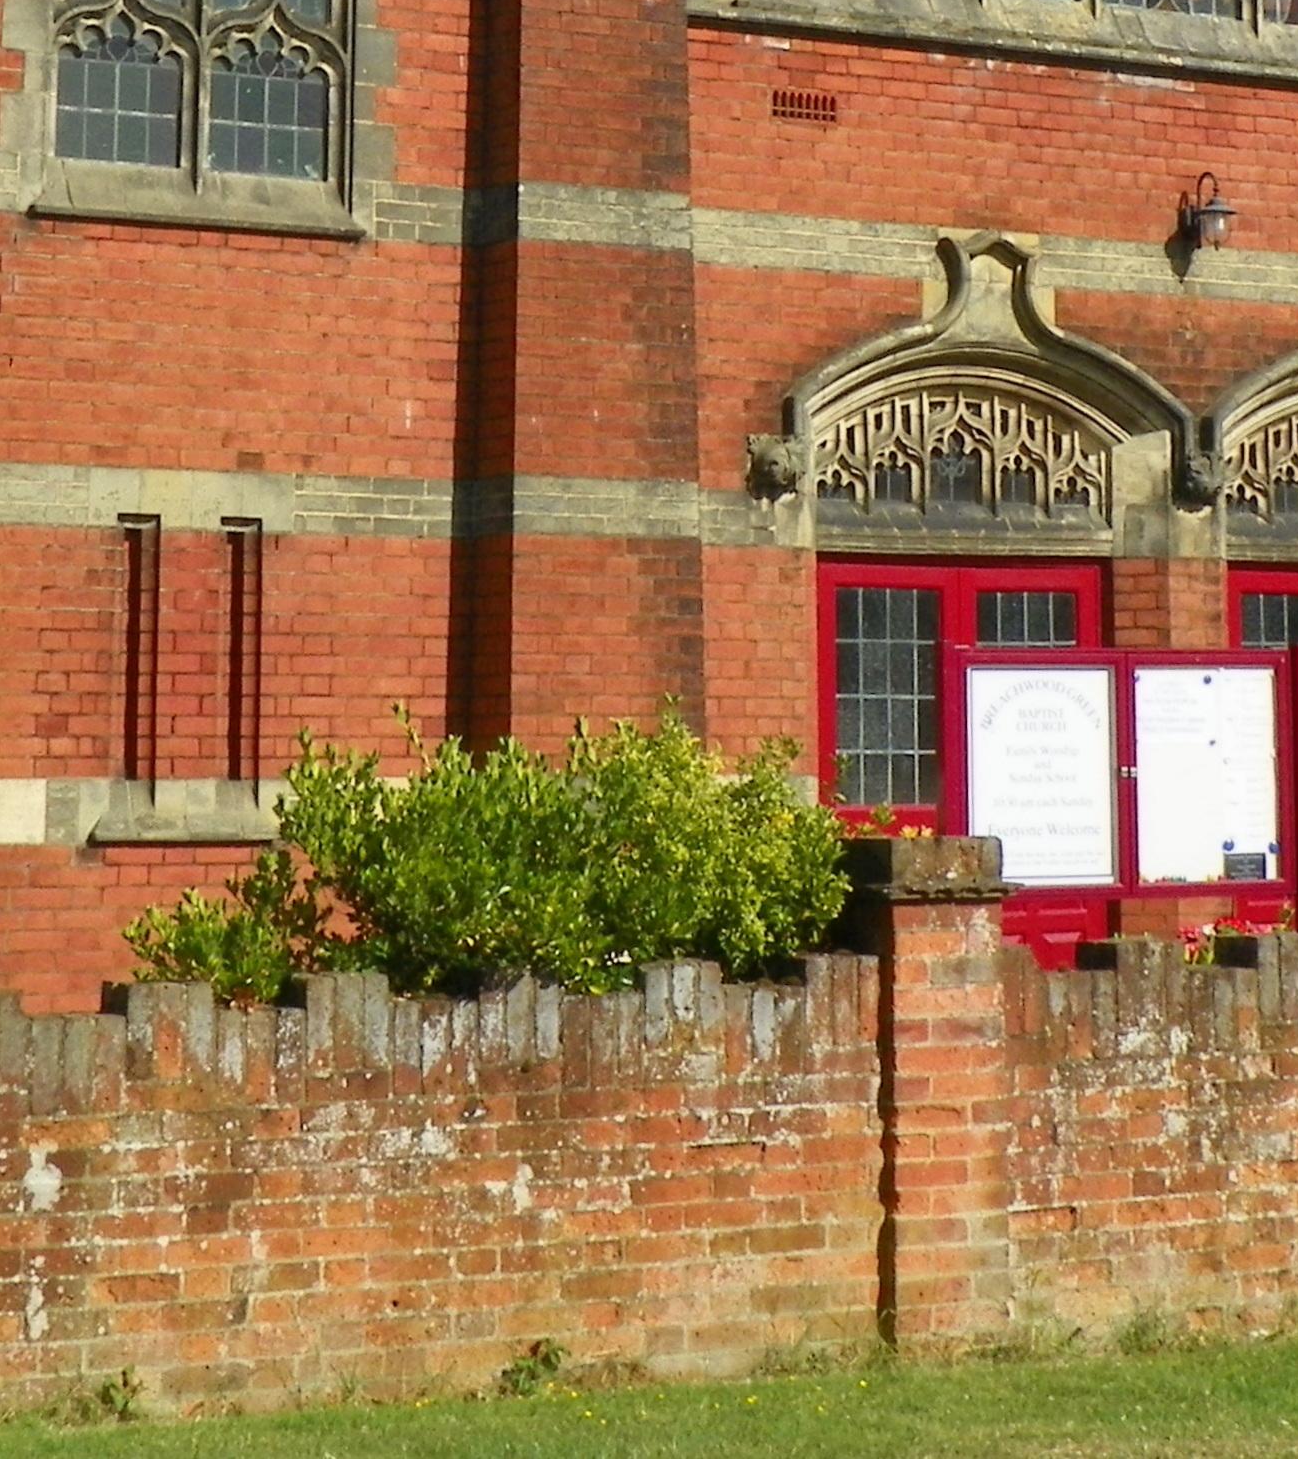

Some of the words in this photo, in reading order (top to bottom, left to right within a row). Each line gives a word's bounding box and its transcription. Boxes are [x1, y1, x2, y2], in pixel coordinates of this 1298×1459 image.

[1018, 708, 1064, 719] BAPTIST
[1015, 721, 1067, 732] CHURCH
[987, 822, 1042, 841] Everyone
[1045, 821, 1103, 837] Welcome
